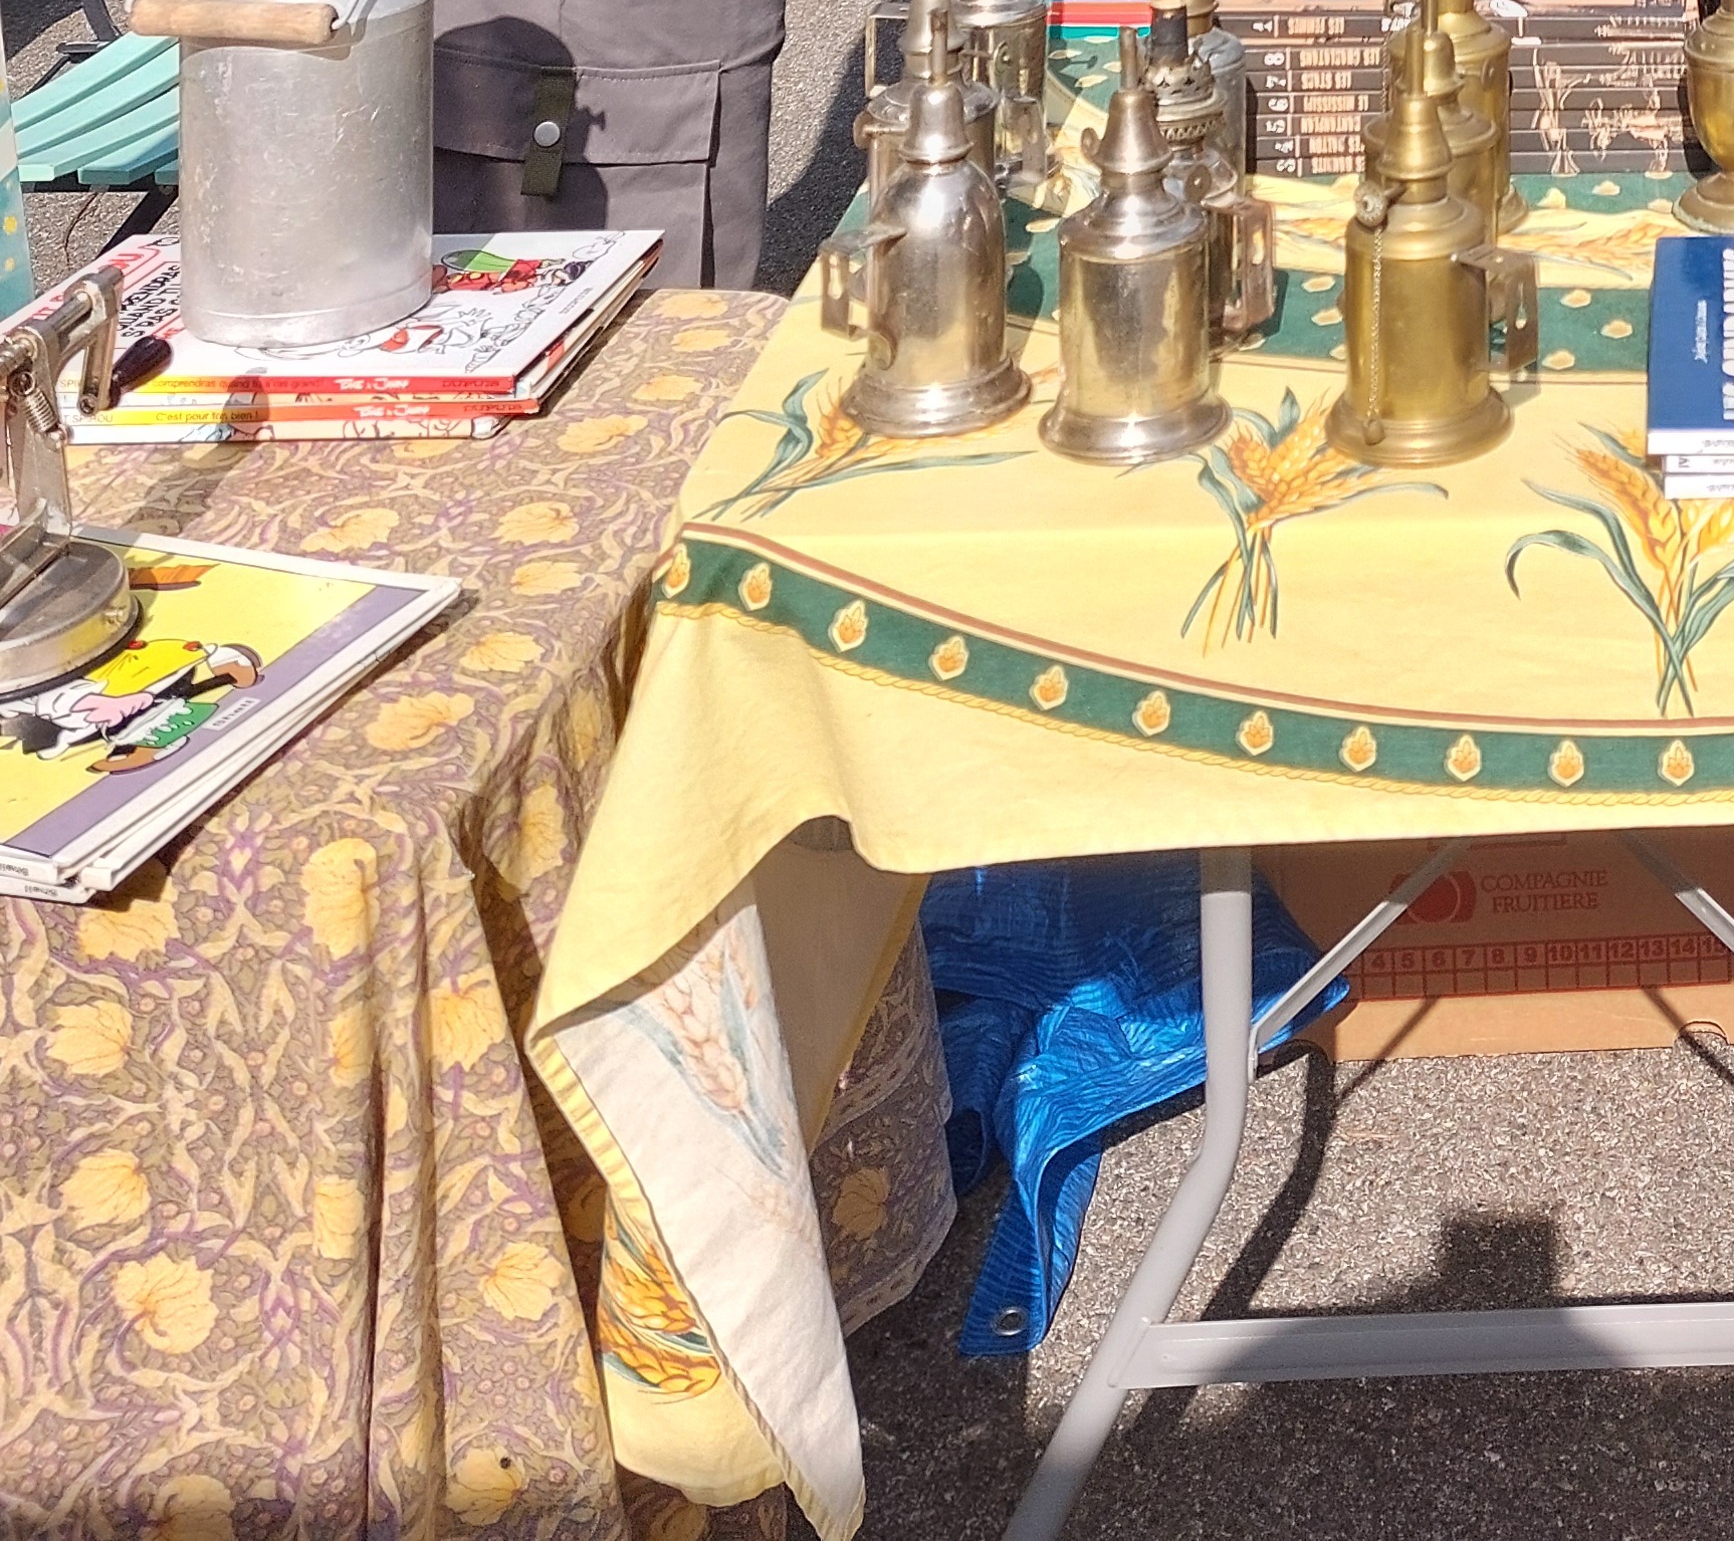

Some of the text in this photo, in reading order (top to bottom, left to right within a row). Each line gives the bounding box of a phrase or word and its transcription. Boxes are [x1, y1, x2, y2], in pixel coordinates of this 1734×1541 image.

[1328, 17, 1344, 34] LES
[1264, 53, 1284, 65] 8
[1363, 48, 1380, 66] LES
[1335, 72, 1351, 89] LES
[1268, 98, 1288, 111] 6
[156, 412, 183, 421] C'est
[185, 412, 210, 423] pour
[231, 411, 254, 420] bien
[1480, 870, 1609, 892] COMPAGNIE
[1492, 892, 1600, 914] FRUITIERE
[1371, 952, 1386, 968] 4
[1401, 951, 1415, 967] 5
[1432, 951, 1446, 966] 6
[1462, 949, 1476, 966] 7
[1492, 947, 1506, 963] 8
[1523, 947, 1537, 963] 9
[1548, 945, 1573, 961] 10
[1579, 943, 1601, 960] 11
[1609, 941, 1634, 959] 12
[1640, 940, 1665, 957] 13
[1670, 938, 1695, 956] 14
